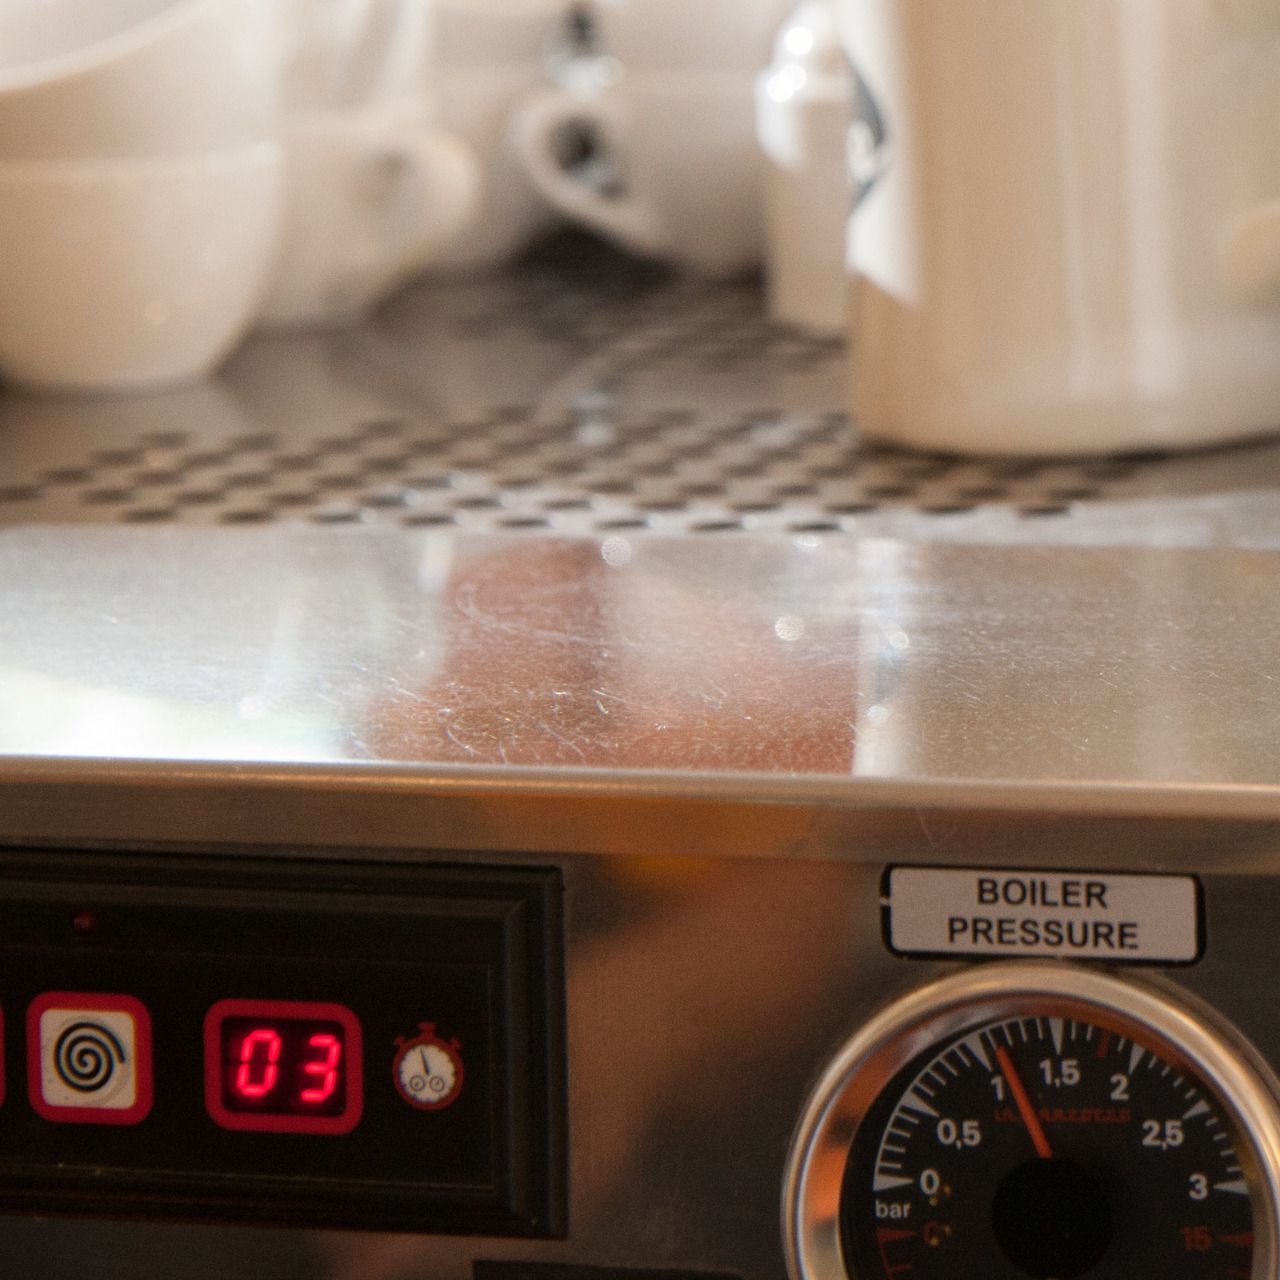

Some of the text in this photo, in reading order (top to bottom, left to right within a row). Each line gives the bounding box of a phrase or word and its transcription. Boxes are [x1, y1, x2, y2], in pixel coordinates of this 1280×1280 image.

[977, 878, 1108, 909] BOILER
[948, 917, 1139, 951] PRESSURE
[235, 1028, 341, 1104] 03
[1110, 1075, 1130, 1101] 2
[919, 1168, 941, 1195] 0
[1188, 1174, 1209, 1201] 3
[875, 1197, 912, 1220] bar
